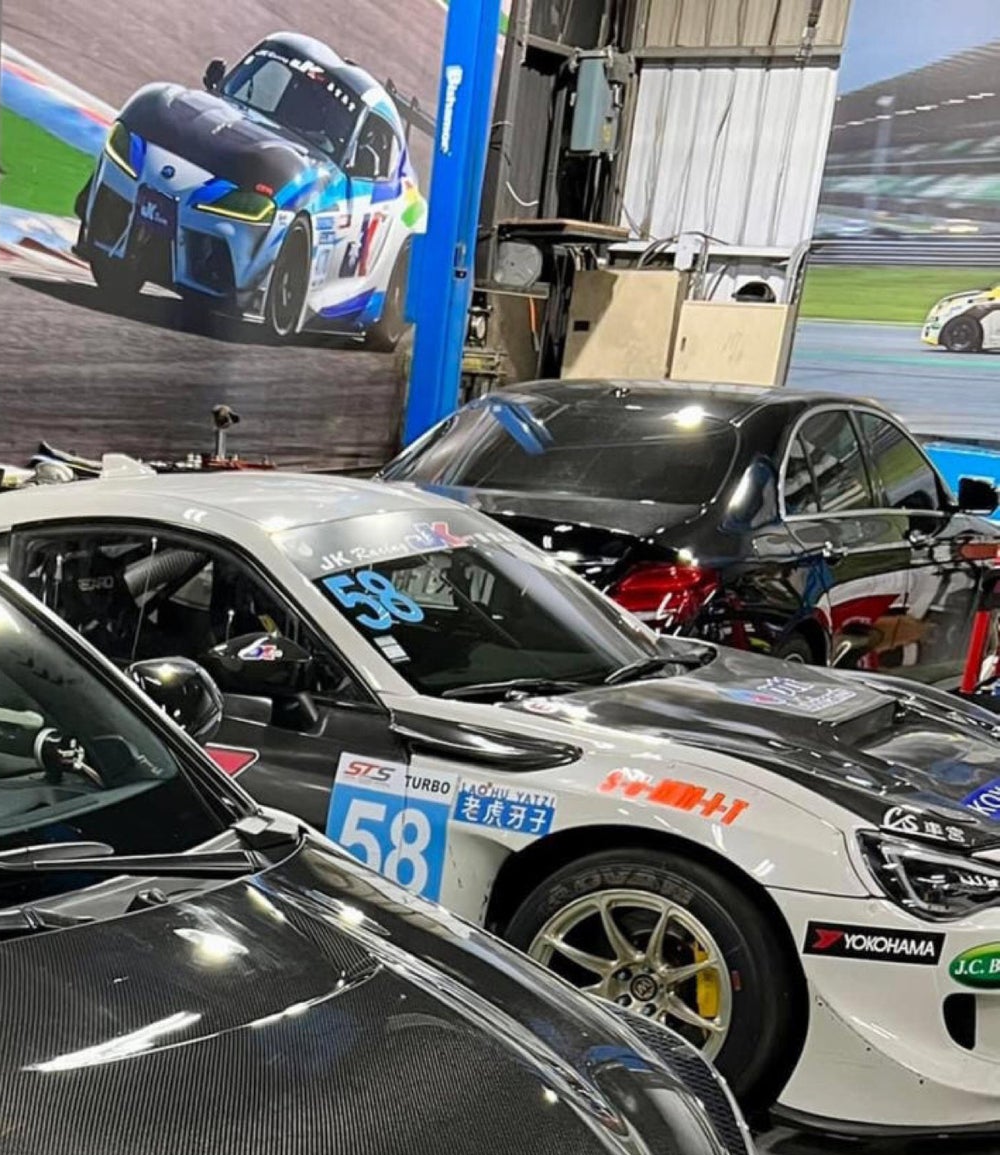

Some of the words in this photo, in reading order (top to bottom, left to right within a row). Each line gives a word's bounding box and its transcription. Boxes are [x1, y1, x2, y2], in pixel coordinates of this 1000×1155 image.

[320, 551, 351, 571] JK
[322, 569, 425, 631] 58
[343, 761, 396, 782] STS
[404, 775, 452, 796] TURBO
[460, 795, 547, 834] 老虎牙子
[338, 797, 432, 897] 58
[843, 932, 936, 957] YOKOHAMA
